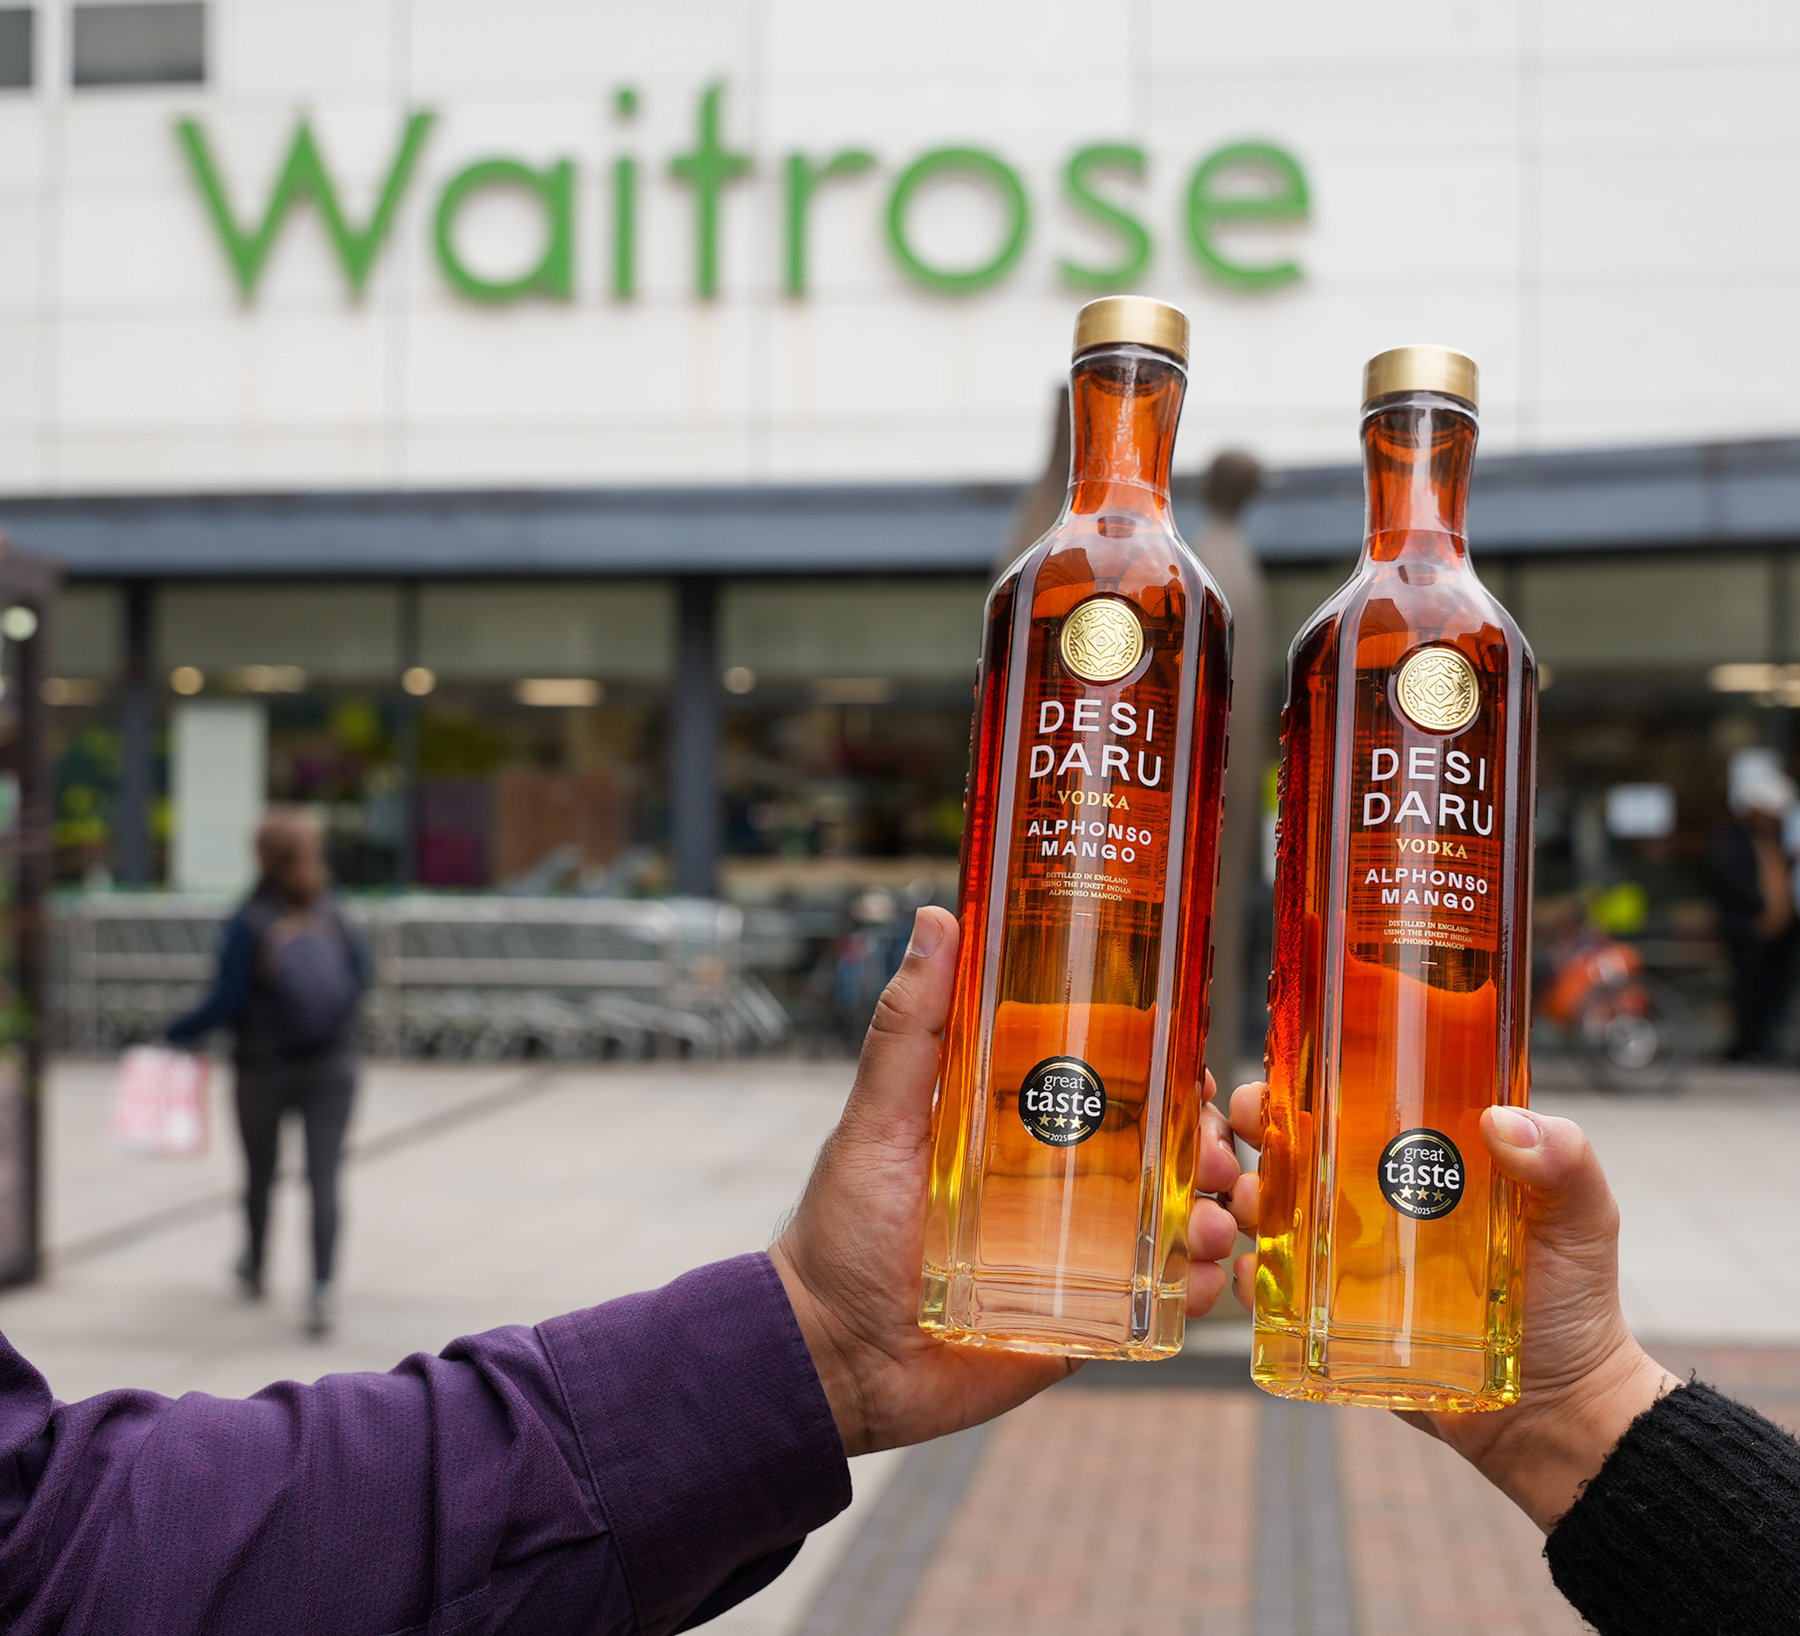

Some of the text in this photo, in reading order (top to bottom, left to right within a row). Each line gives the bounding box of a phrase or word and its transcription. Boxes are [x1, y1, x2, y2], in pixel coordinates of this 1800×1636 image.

[172, 82, 1313, 305] Waitrose
[1039, 699, 1154, 742] DESI
[1029, 743, 1162, 787] DARU
[1371, 747, 1486, 791] DESI
[1058, 790, 1129, 810] VODKA
[1363, 790, 1493, 836] DARU
[1027, 820, 1152, 846] ALPHONSO
[1041, 841, 1136, 863] MANGO
[1396, 838, 1468, 859] VODKA
[1063, 880, 1079, 888] THE
[1080, 881, 1105, 890] FINEST
[1106, 884, 1131, 894] INDIAN
[1094, 874, 1128, 885] ENGLAND
[1364, 868, 1488, 894] ALPHONSO
[1049, 889, 1122, 901] ALPHONSO MANGOS
[1381, 889, 1475, 912] MANGO
[1388, 920, 1426, 928] DISTILLED
[1438, 923, 1469, 933] ENGLAND
[1424, 930, 1449, 939] FINEST
[1450, 933, 1473, 943] INDIAN
[1392, 938, 1465, 950] ALPHONSO MANGOS
[1043, 1075, 1085, 1091] great
[1025, 1088, 1101, 1117] taste
[1050, 1133, 1067, 1142] 2025
[1403, 1147, 1445, 1163] great
[1384, 1160, 1460, 1189] taste
[1413, 1206, 1430, 1215] 2025
